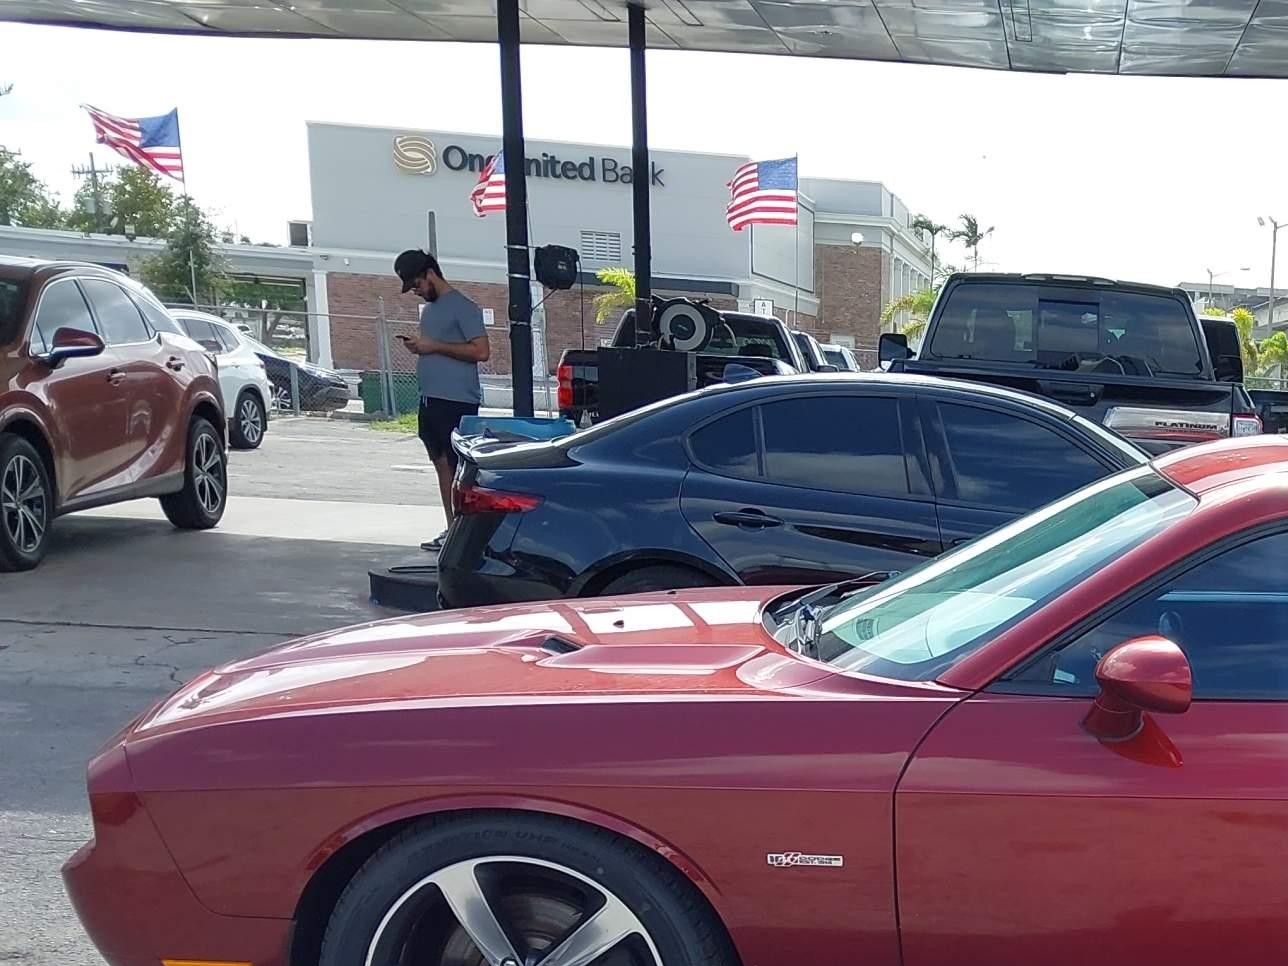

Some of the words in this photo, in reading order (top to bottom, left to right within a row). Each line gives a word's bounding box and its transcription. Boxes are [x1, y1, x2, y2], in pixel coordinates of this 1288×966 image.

[442, 145, 595, 181] Onnited
[602, 158, 664, 187] Bak
[1154, 421, 1218, 430] PLATINUM
